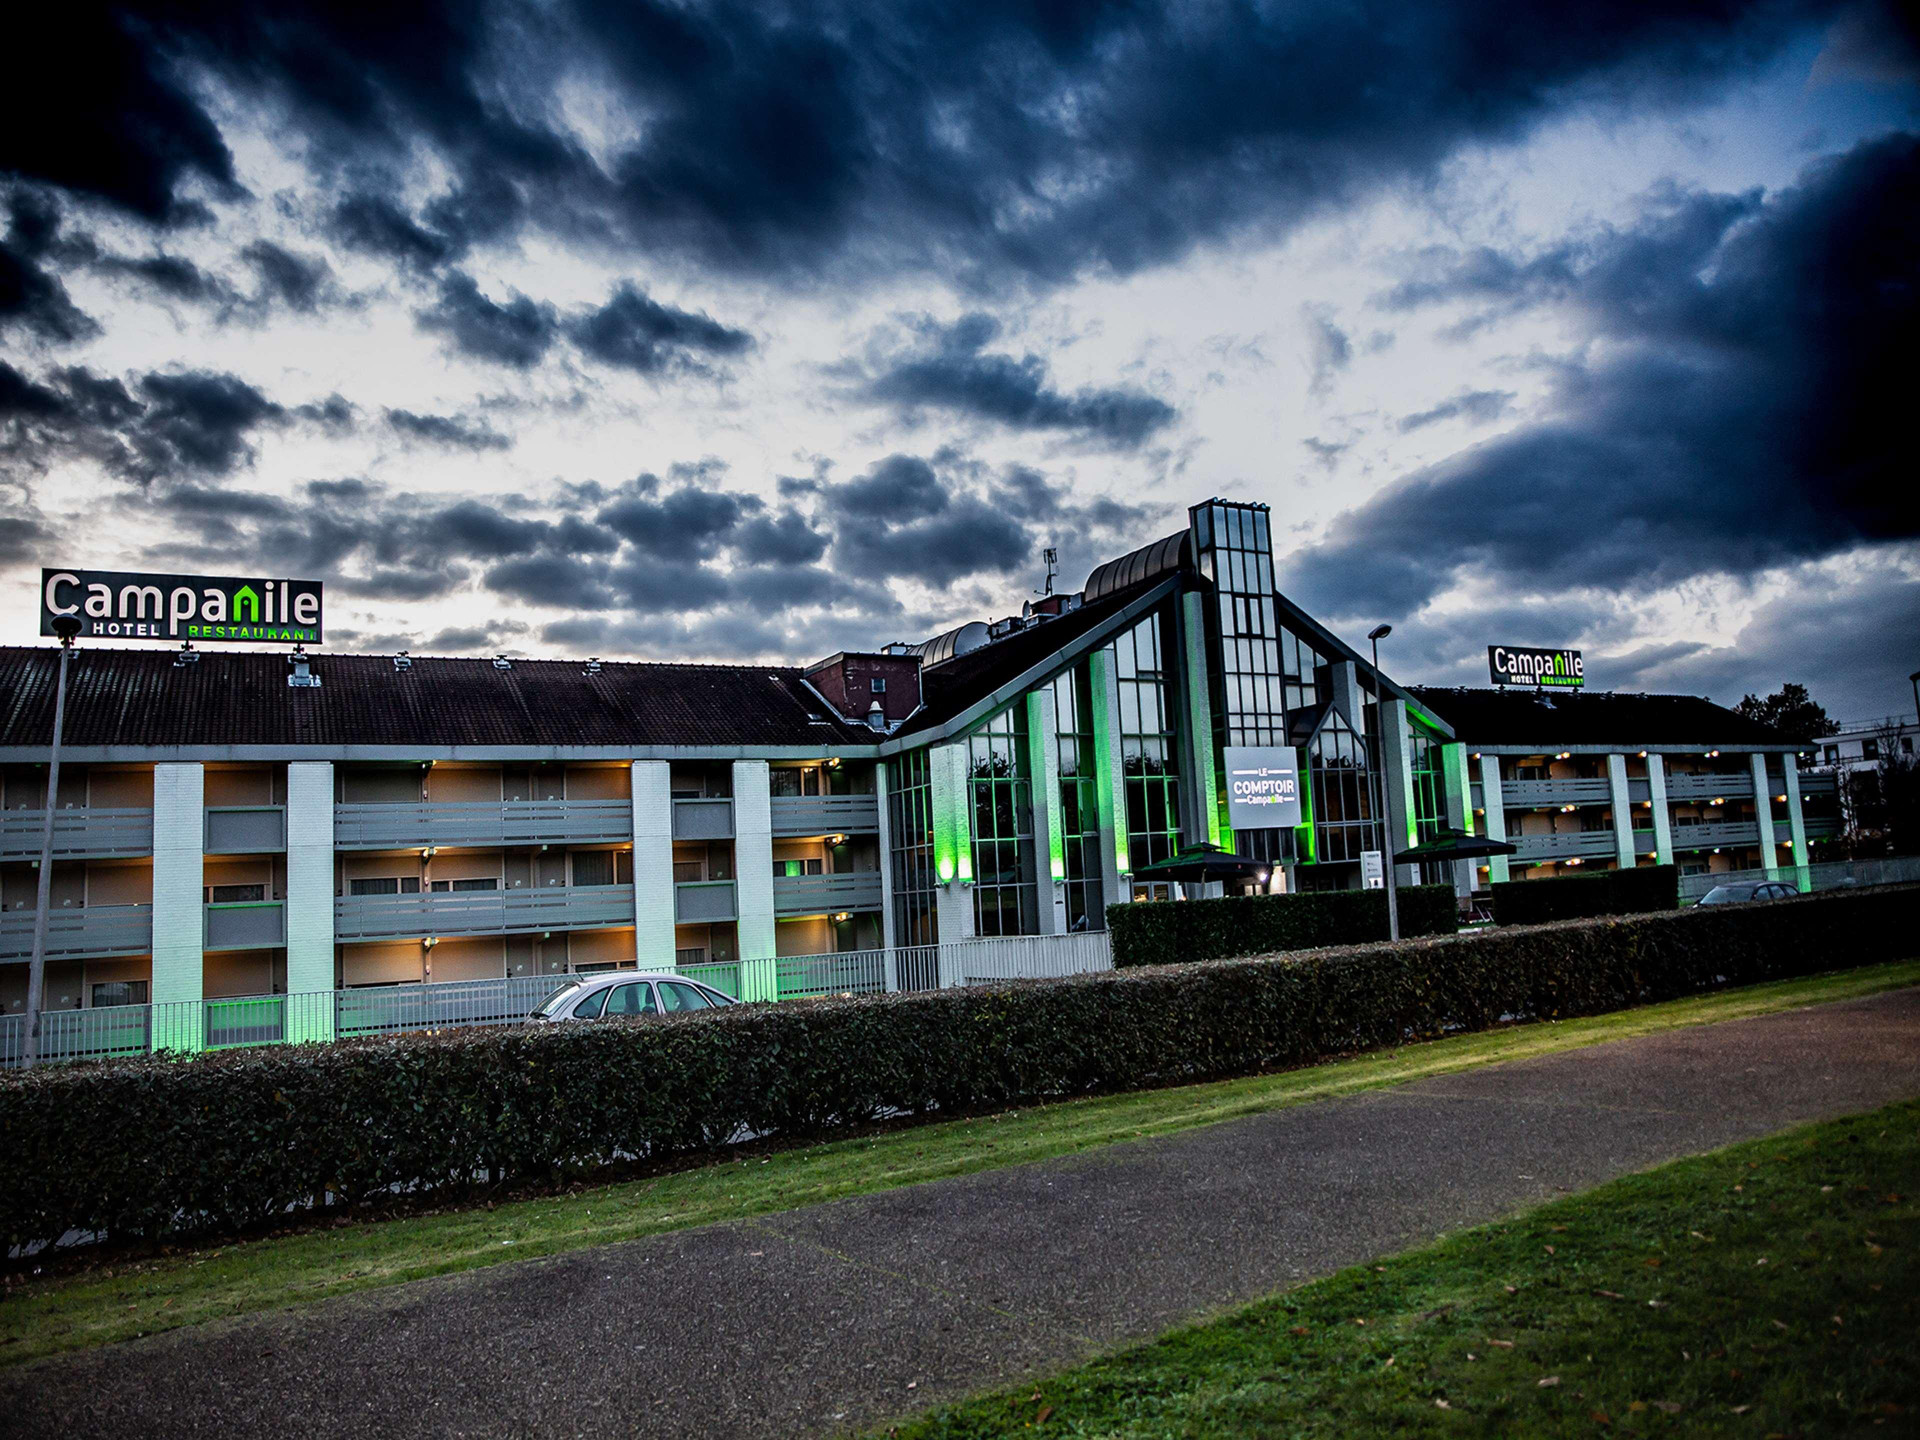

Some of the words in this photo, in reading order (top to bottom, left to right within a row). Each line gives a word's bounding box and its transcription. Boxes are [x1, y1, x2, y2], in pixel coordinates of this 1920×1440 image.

[45, 572, 319, 636] Campanile
[92, 622, 160, 637] HOTEL
[188, 624, 318, 641] RESTAURANT
[1494, 647, 1584, 684] Campanile
[1510, 674, 1534, 684] HOTEL
[1541, 675, 1585, 685] RESTAURANT
[1258, 767, 1268, 777] LE
[1233, 779, 1295, 795] COMPTOIR
